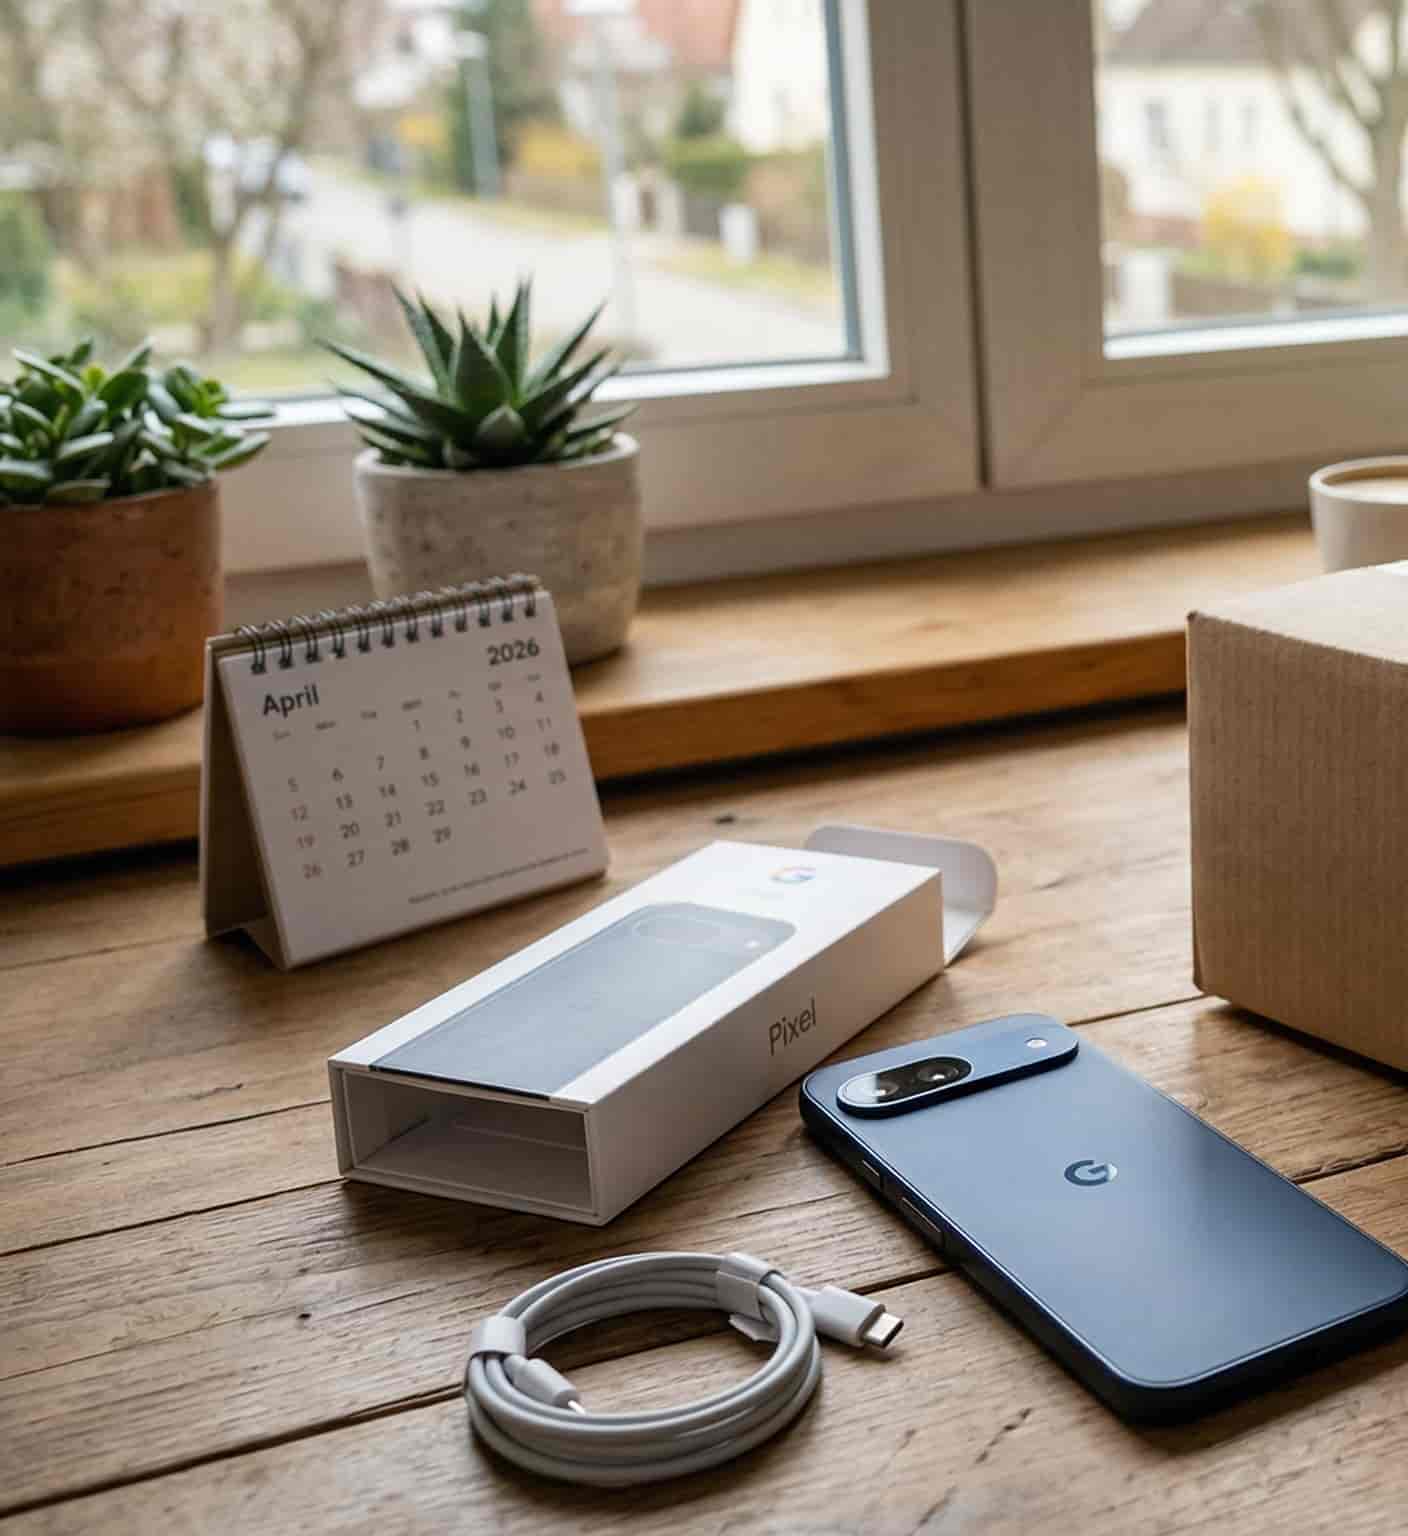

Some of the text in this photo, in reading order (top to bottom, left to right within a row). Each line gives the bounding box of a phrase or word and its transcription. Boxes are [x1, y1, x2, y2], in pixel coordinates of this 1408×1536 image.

[488, 637, 540, 666] 2026
[262, 683, 319, 719] April
[768, 996, 816, 1056] Pixel
[1063, 1159, 1118, 1187] G
